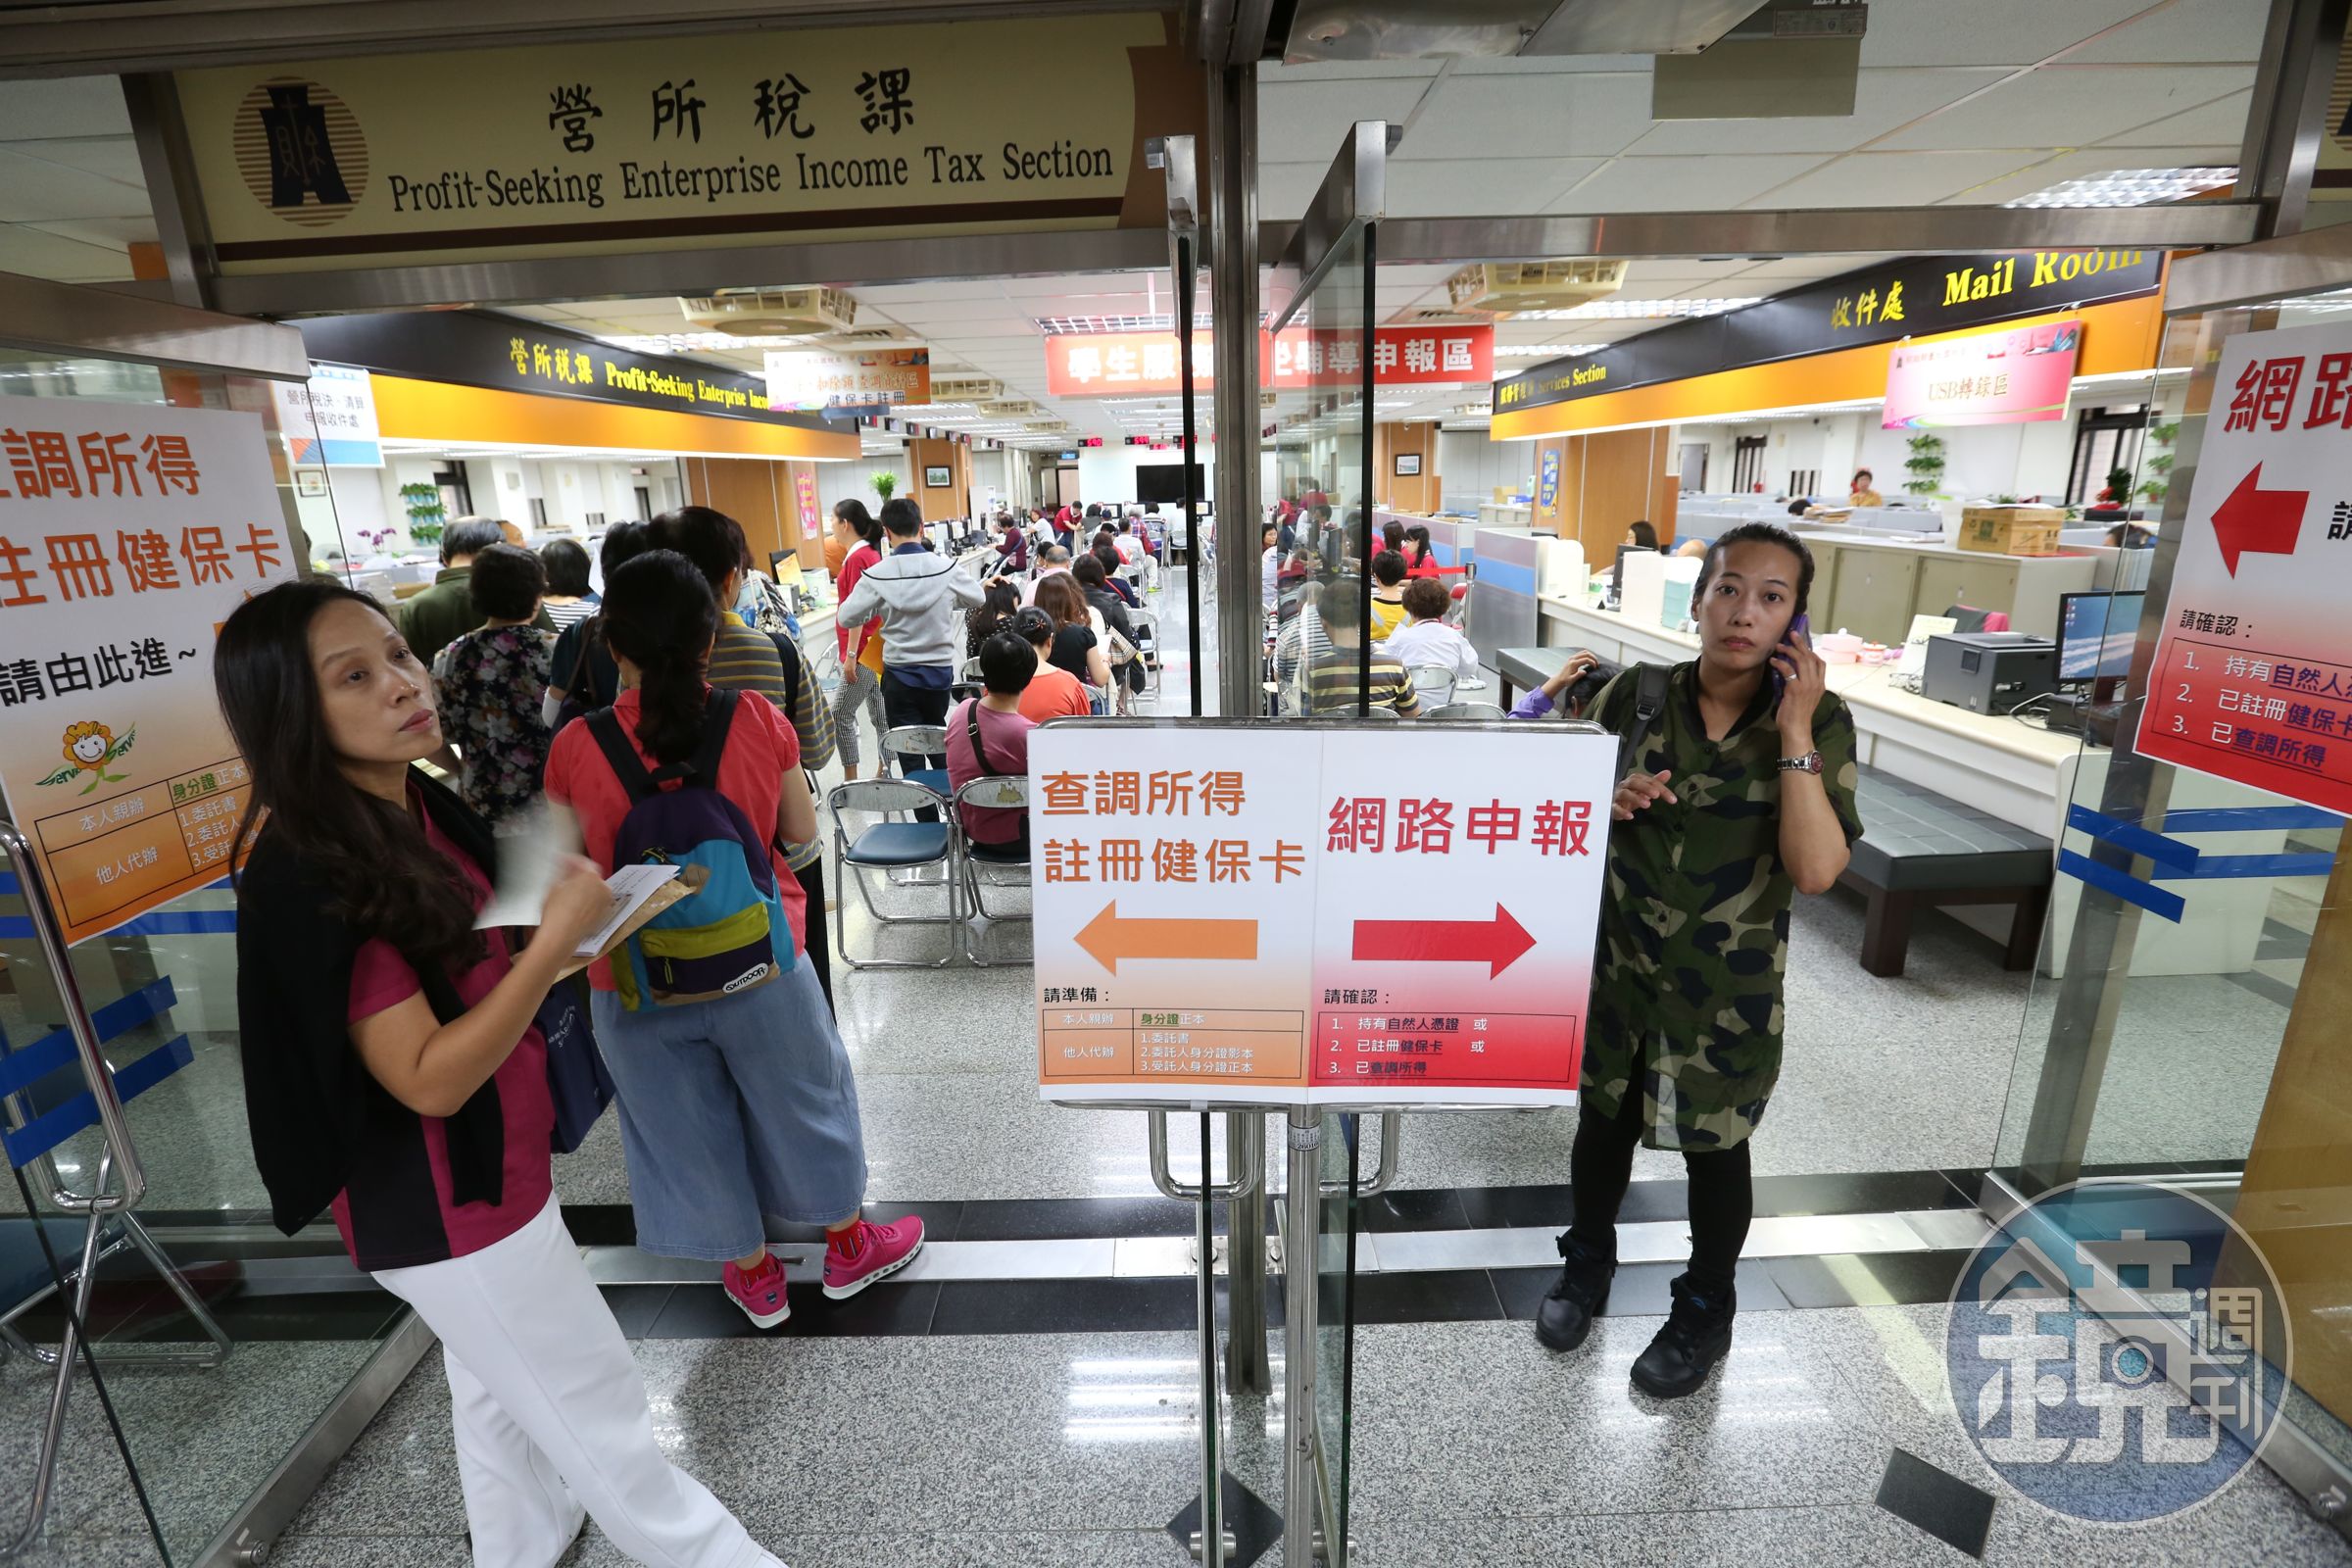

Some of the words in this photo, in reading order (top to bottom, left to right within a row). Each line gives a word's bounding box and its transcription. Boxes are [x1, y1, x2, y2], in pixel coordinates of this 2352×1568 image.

[388, 170, 606, 212] Profit-Seeking
[620, 155, 782, 202] Enterprise
[798, 146, 908, 190] Income
[924, 146, 986, 184] Tax
[1003, 139, 1113, 181] Section
[1831, 280, 1905, 330] 收件處
[1942, 258, 2015, 306] Mail
[604, 361, 695, 403] Profit-Seeking
[698, 378, 747, 409] Enterprise
[1573, 364, 1606, 387] Section
[828, 391, 906, 408] 健保卡註冊
[0, 428, 201, 499] 調所得
[2183, 652, 2200, 670] 1.
[2225, 655, 2352, 699] 持有自然人
[2176, 684, 2193, 703] 2.
[2172, 715, 2188, 734] 3.
[2211, 721, 2328, 768] 已查調所得
[1041, 770, 1247, 816] 查調所得
[79, 798, 145, 832] 本人親辦
[1326, 796, 1592, 858] 網路申報
[95, 847, 160, 885] 他人代辦
[1044, 838, 1306, 884] 註冊健保卡
[725, 966, 765, 991] OUTDOOR
[1062, 1013, 1114, 1025] 本人親辦
[1141, 1013, 1205, 1026] 身分證正本
[1332, 1018, 1344, 1030] 1.
[1357, 1017, 1459, 1032] 持有自然人憑證
[1474, 1018, 1489, 1031] 或
[1064, 1047, 1114, 1058] 他人代辦
[1330, 1041, 1343, 1052] 2.
[1356, 1039, 1444, 1054] 已註冊健保卡
[1471, 1040, 1486, 1054] 或
[1329, 1062, 1341, 1073] 3.
[1355, 1061, 1427, 1075] 已查調所得
